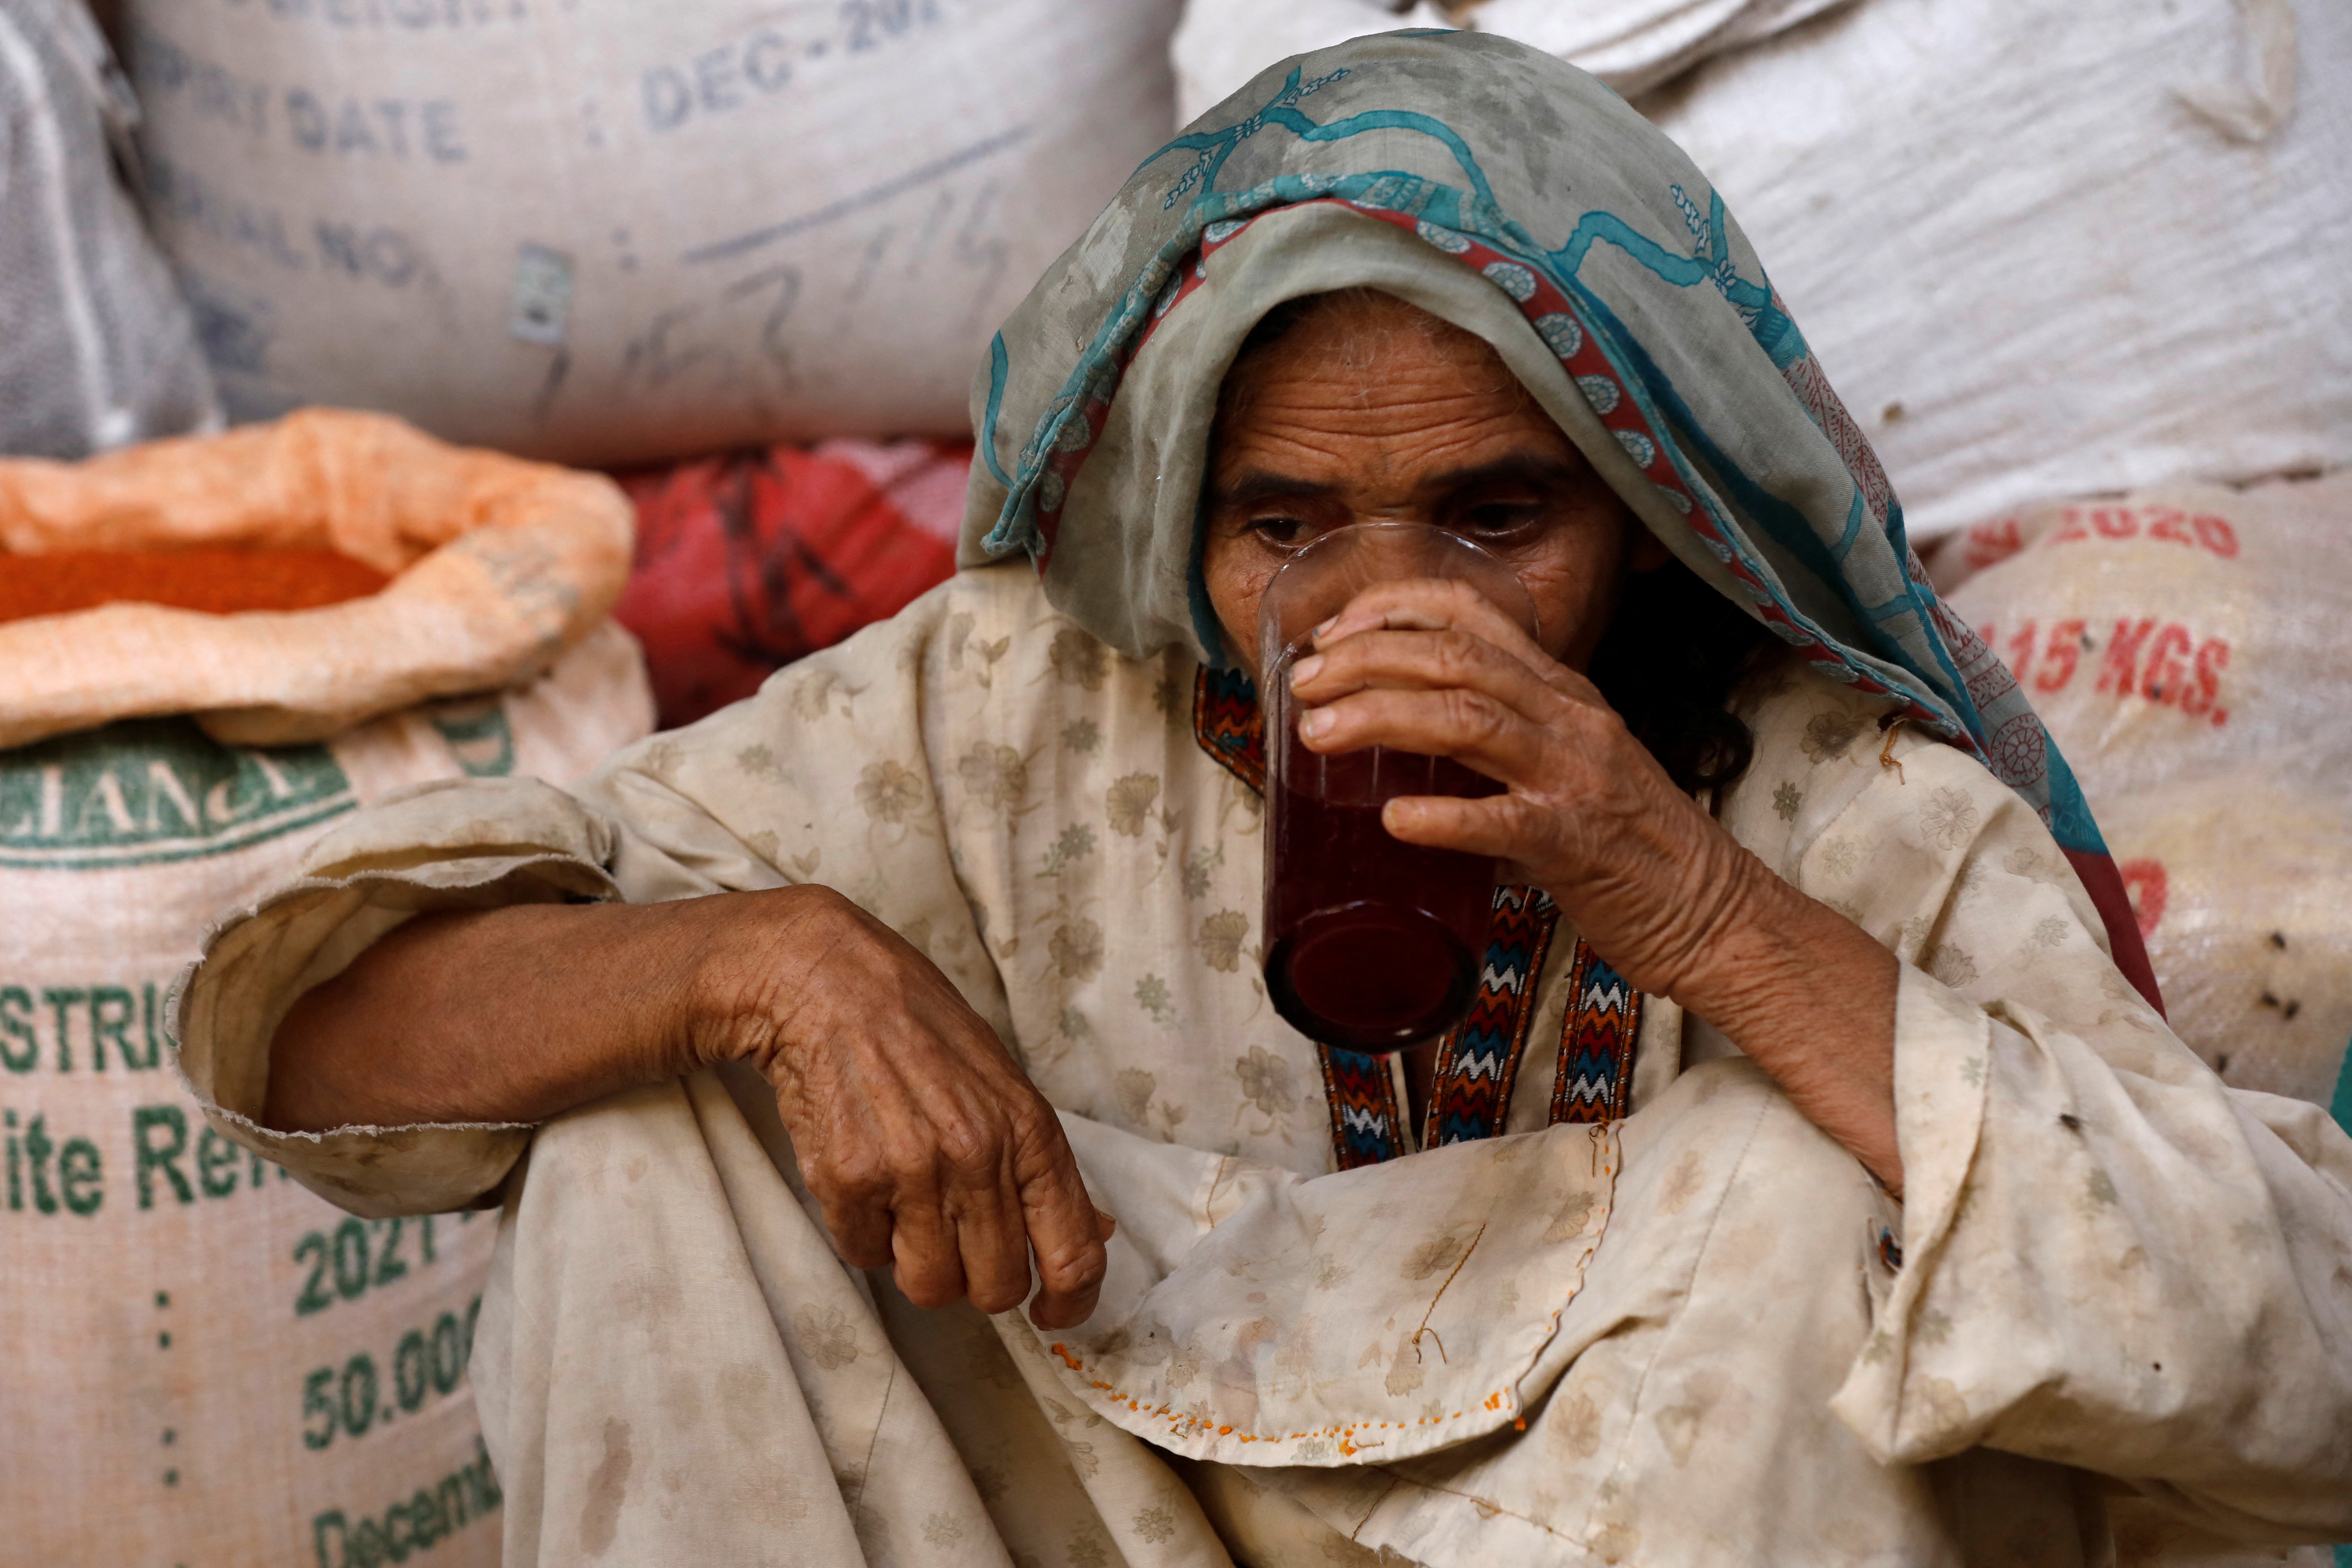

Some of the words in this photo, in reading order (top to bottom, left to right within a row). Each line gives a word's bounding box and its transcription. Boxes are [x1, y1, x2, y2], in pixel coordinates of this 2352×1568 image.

[285, 86, 470, 164] DATE
[2049, 504, 2240, 559] 2020
[2095, 618, 2231, 727] KGS.
[0, 981, 180, 1075] STRI
[5, 1108, 104, 1218] ite
